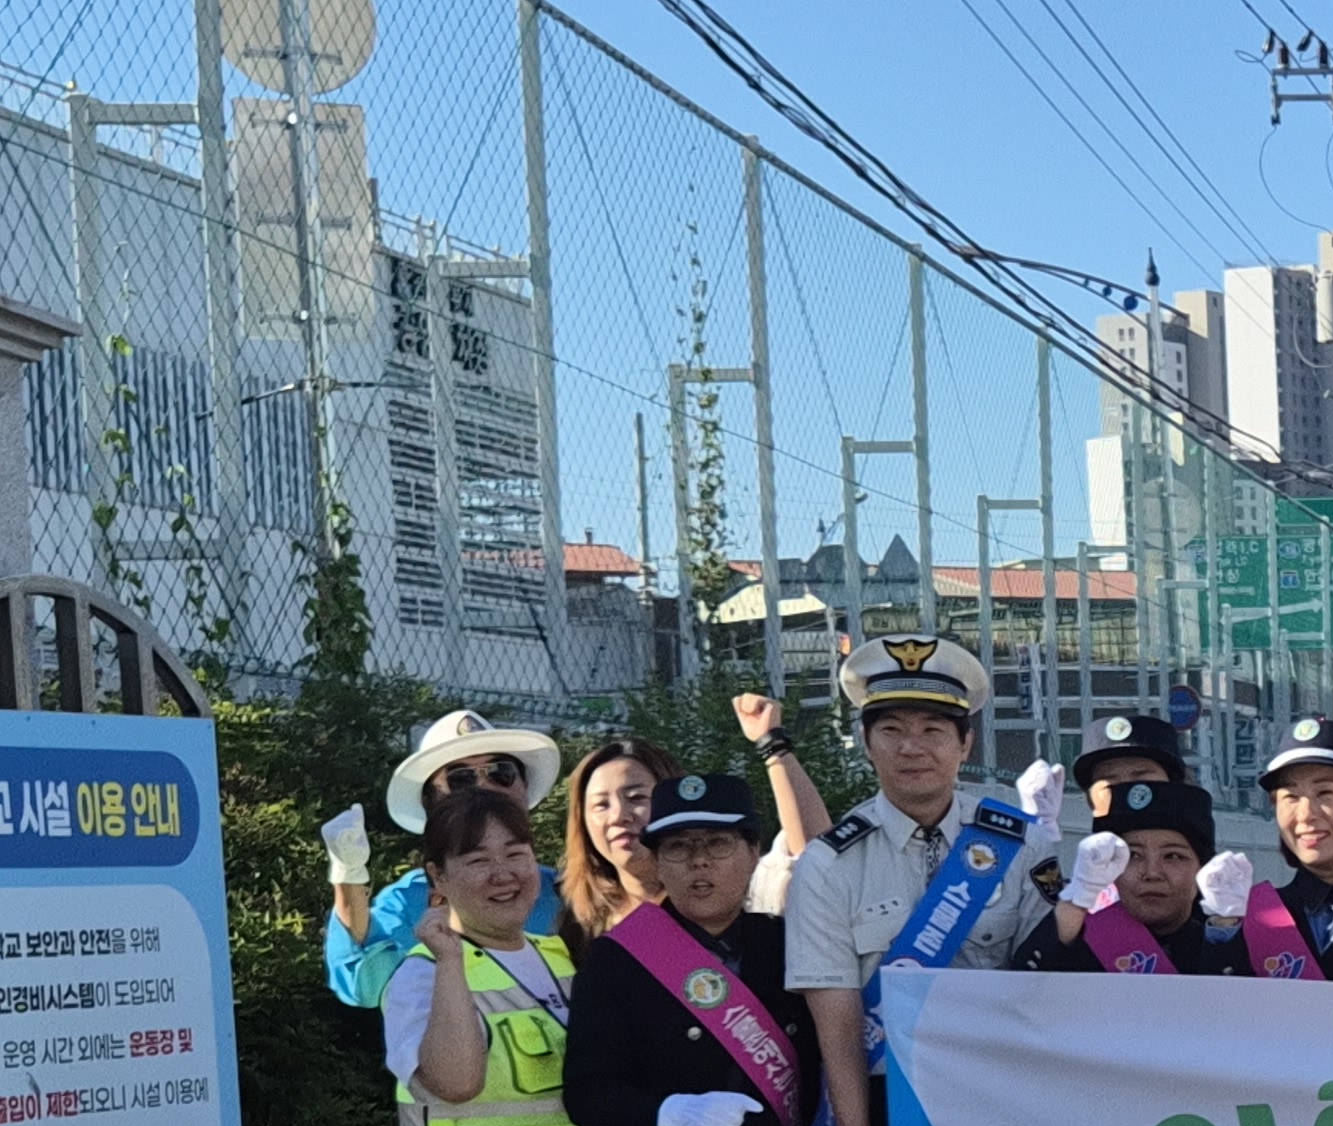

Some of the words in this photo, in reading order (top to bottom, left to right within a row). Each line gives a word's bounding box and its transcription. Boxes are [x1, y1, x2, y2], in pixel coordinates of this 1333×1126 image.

[20, 780, 72, 837] 시설
[77, 782, 127, 838] 이용
[131, 782, 181, 838] 안내
[0, 931, 22, 960] 교
[26, 929, 76, 958] 보안과
[79, 927, 126, 956] 안전을
[130, 927, 161, 952] 위해
[114, 977, 176, 1006] 도입되어
[3, 1039, 36, 1069] 운영
[41, 1036, 73, 1065] 시간
[78, 1033, 126, 1061] 외에는
[129, 1029, 174, 1058] 운동장
[178, 1027, 193, 1054] 및
[45, 1084, 126, 1118] 제한되오니
[131, 1081, 162, 1109] 시설
[165, 1076, 210, 1106] 이용에
